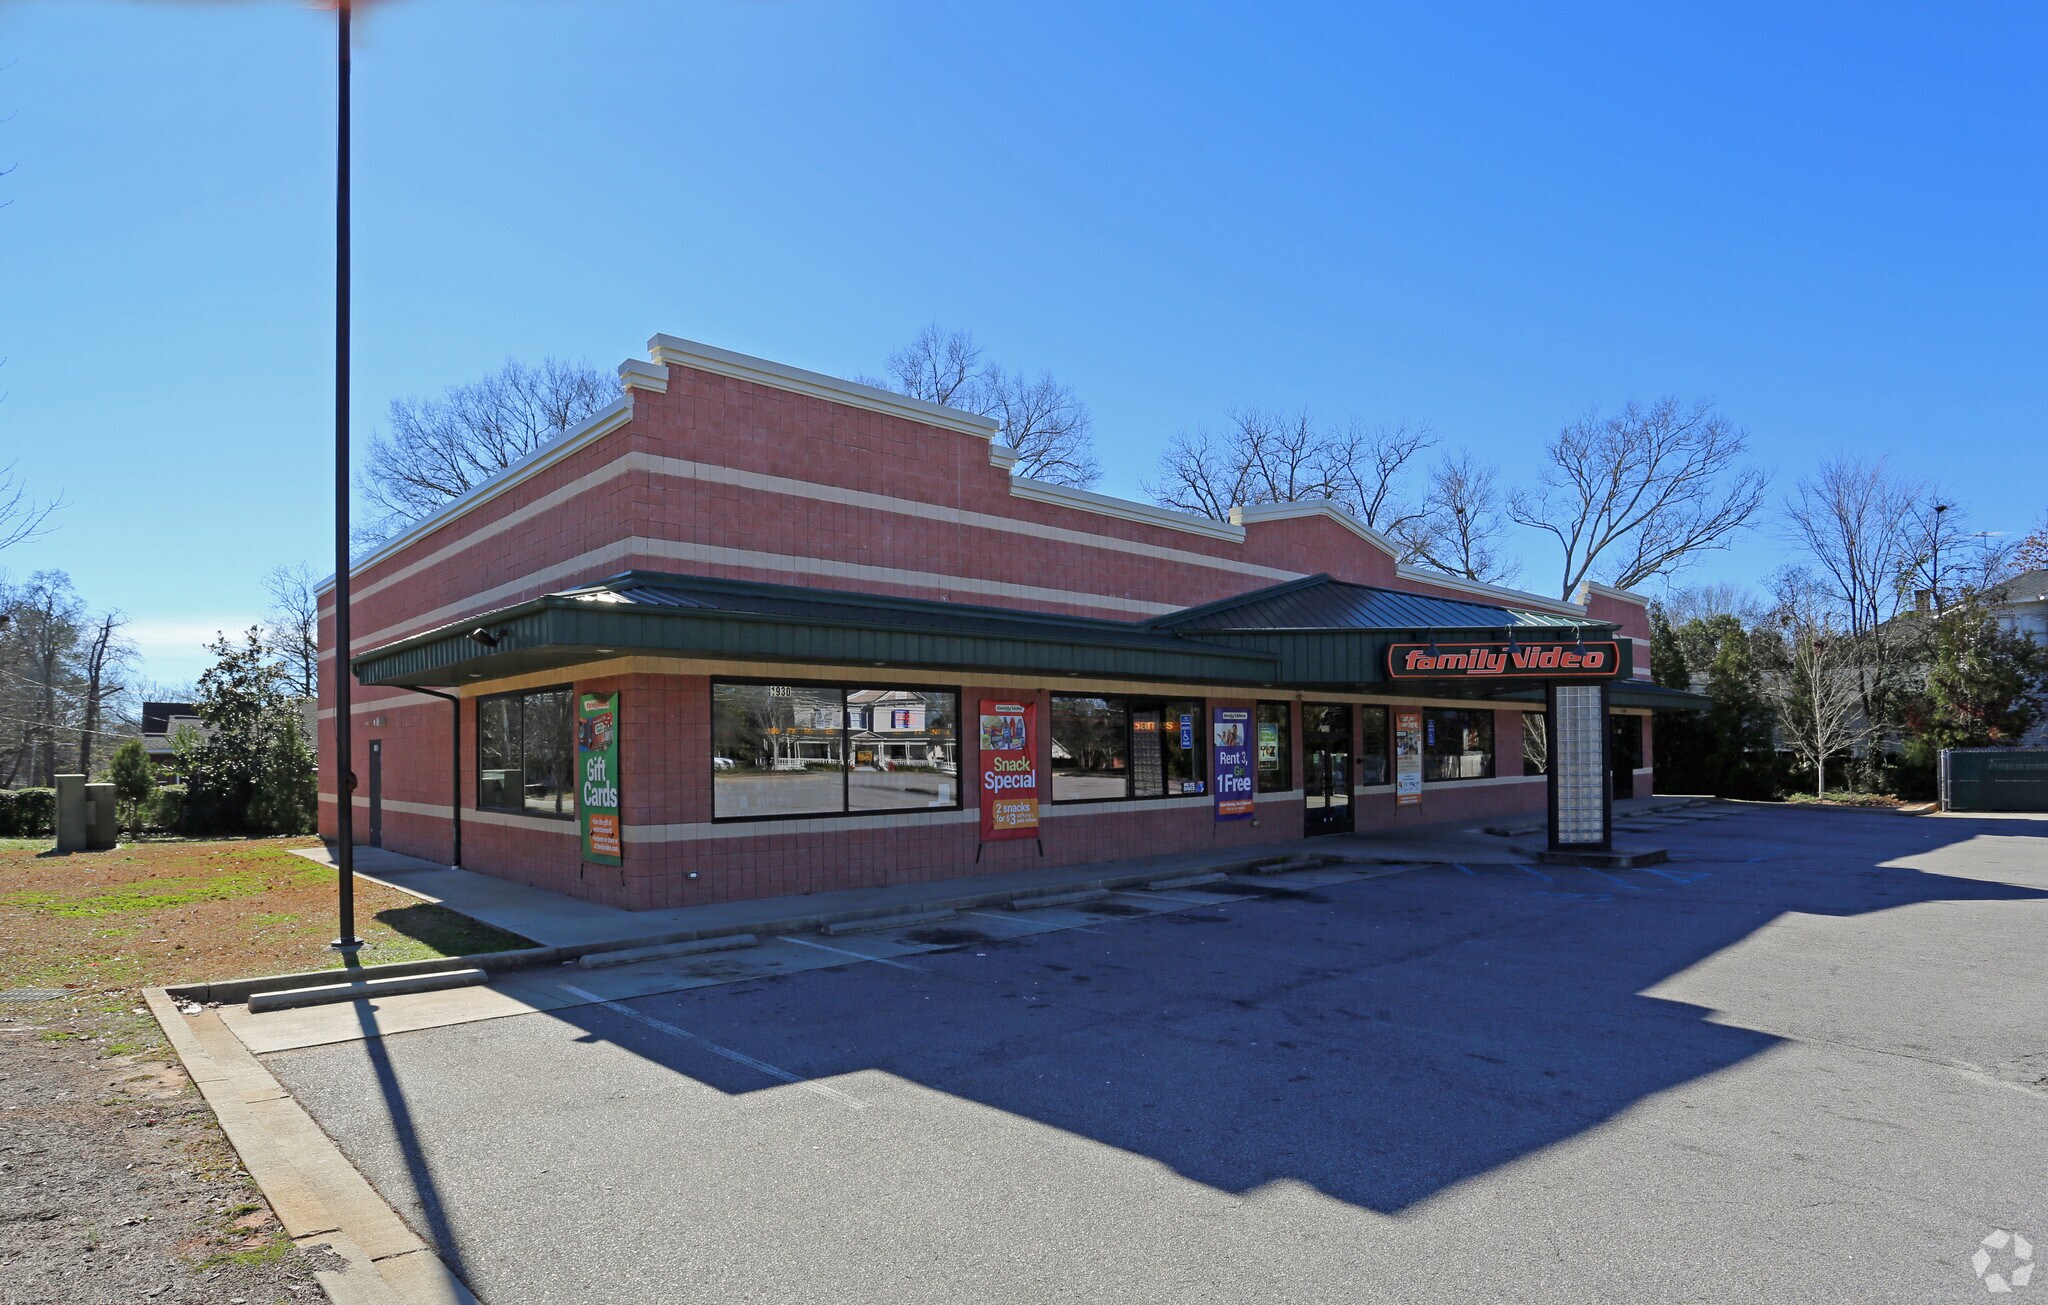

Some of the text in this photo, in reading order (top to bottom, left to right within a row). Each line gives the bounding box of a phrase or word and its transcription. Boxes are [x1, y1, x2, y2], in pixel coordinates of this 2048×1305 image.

[1406, 646, 1604, 674] family Video
[994, 756, 1031, 772] Snack
[1220, 751, 1248, 766] Rent 3,
[587, 757, 605, 781] Gift
[984, 769, 1035, 793] Special
[1225, 774, 1251, 793] Free
[584, 780, 617, 808] Cards
[996, 801, 1030, 814] 2 snacks
[996, 813, 1005, 823] for
